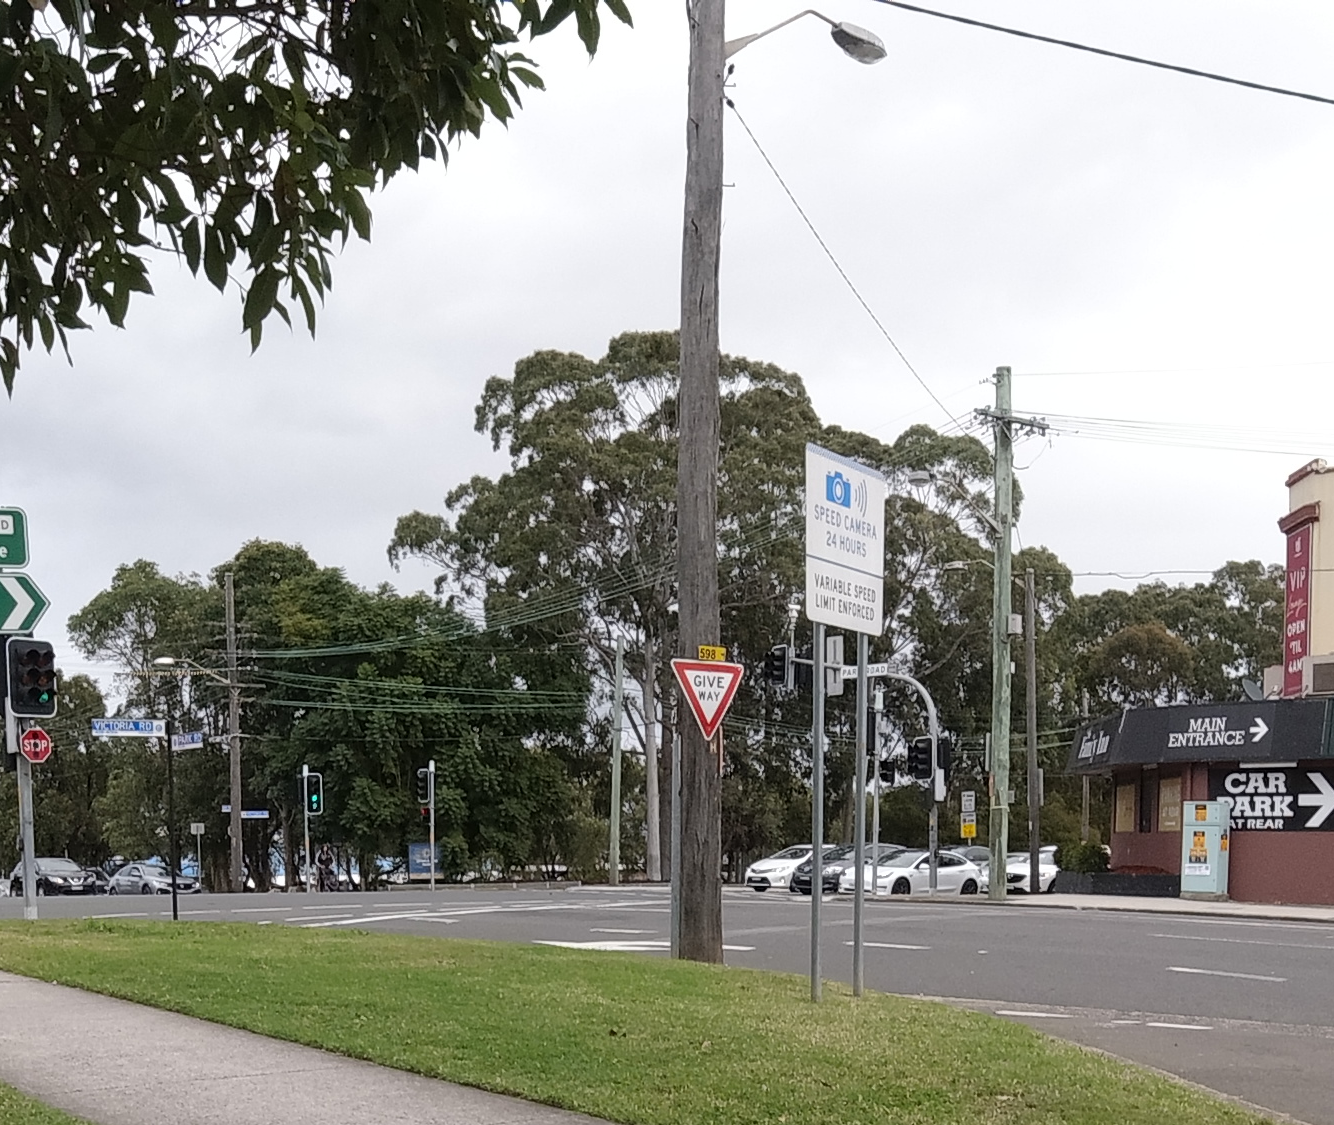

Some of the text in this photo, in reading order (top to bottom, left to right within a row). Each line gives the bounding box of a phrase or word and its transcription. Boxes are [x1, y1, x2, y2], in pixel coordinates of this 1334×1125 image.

[814, 504, 877, 540] SPEED CAMERA
[826, 531, 867, 558] 24 HOURS
[1290, 567, 1306, 592] VIP
[814, 573, 876, 603] VARIABLE SPEED
[815, 594, 875, 621] LIMIT ENFORCED
[1287, 619, 1305, 637] OPEN
[699, 648, 716, 660] 598
[842, 668, 858, 677] PAR
[693, 675, 725, 688] GIVE
[698, 691, 720, 701] WAY
[94, 721, 152, 731] VICTORIA RD
[1188, 717, 1227, 732] MAIN
[24, 739, 47, 752] STOP
[1168, 730, 1245, 748] ENTRANCE
[1224, 772, 1287, 794] CAR
[1247, 819, 1284, 829] REAR
